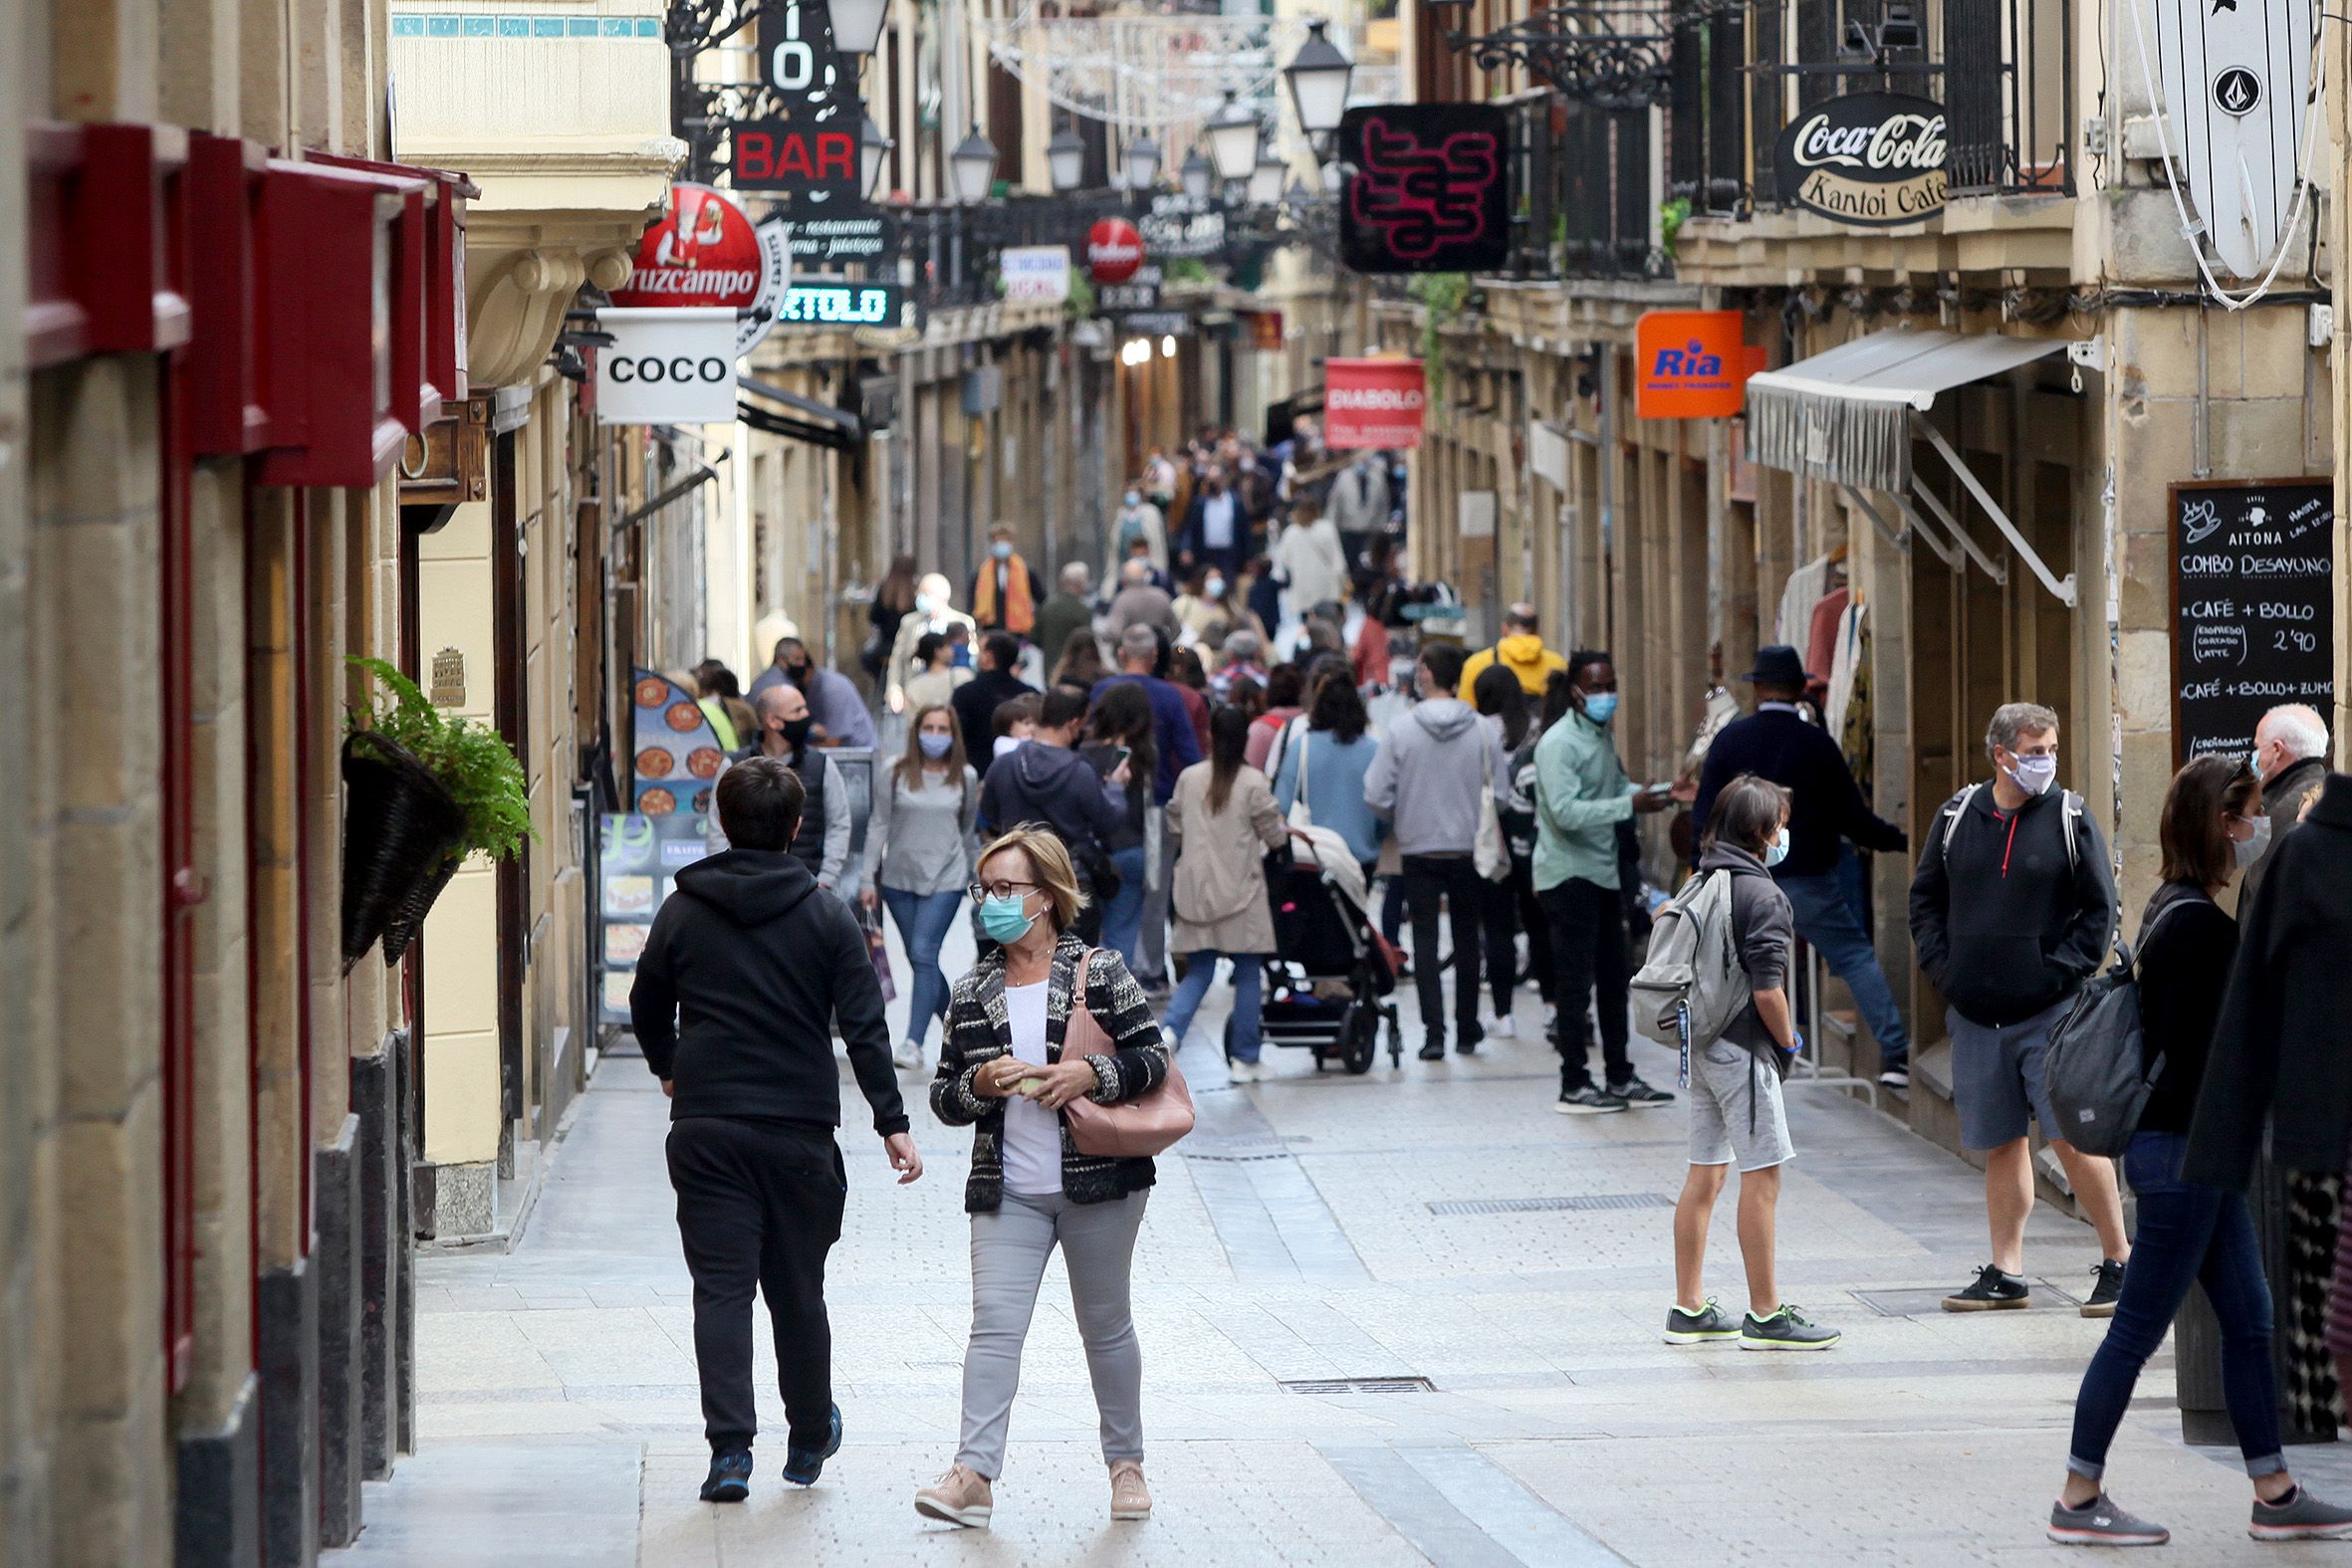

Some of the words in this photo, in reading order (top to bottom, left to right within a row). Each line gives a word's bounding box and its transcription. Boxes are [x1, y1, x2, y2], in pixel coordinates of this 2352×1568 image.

[1793, 113, 1948, 169] Coca-Cola
[736, 130, 854, 180] BAR
[1807, 174, 1887, 216] Kantoi
[1897, 176, 1949, 213] Café
[806, 218, 883, 235] restaurante
[626, 268, 754, 300] ruzcampo
[1654, 336, 1722, 376] Ria
[609, 356, 727, 383] COCO
[1327, 388, 1424, 410] DIABOLO
[2229, 531, 2282, 546] AITONA
[2181, 555, 2234, 573] COMBO
[2240, 554, 2331, 574] DESAYUNO
[2191, 598, 2234, 618] CAFÉ
[2259, 602, 2314, 620] BOLLO
[2273, 629, 2316, 652] 2'90
[2199, 649, 2230, 658] LATTE
[2184, 678, 2221, 700] CAFÉ
